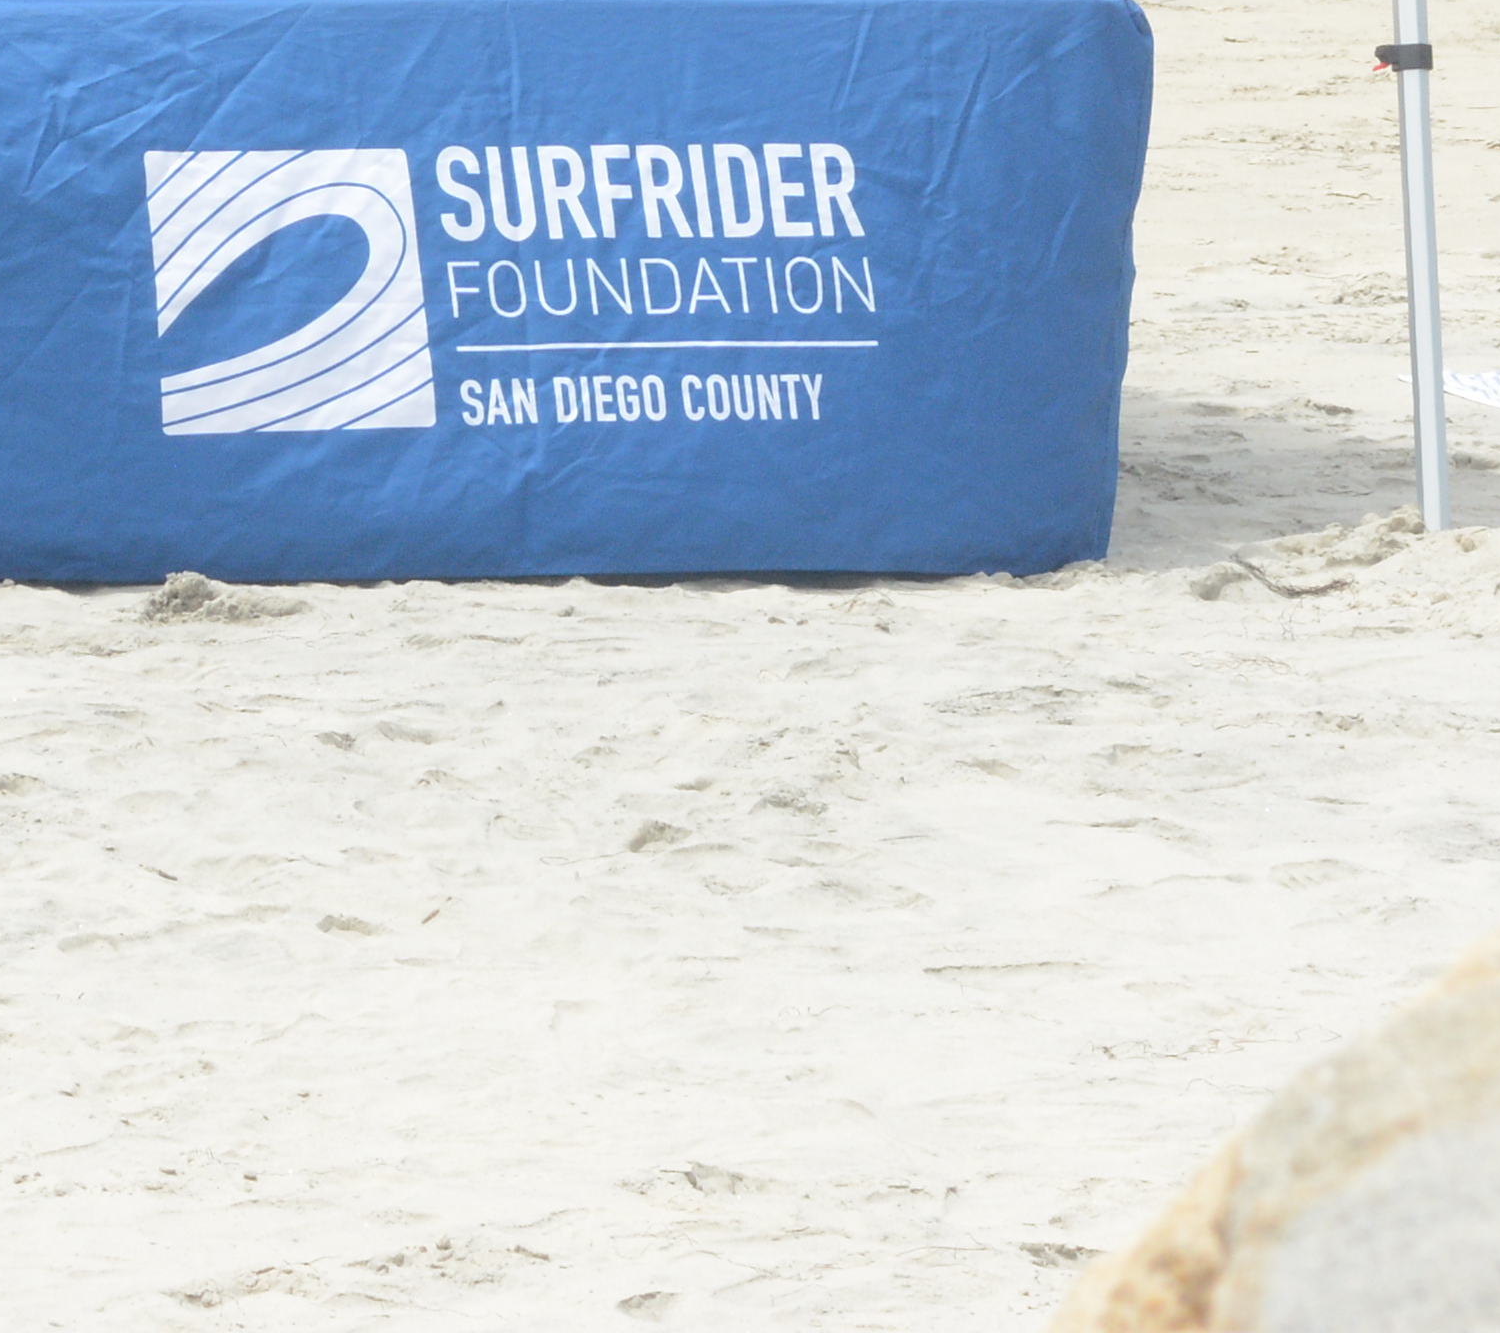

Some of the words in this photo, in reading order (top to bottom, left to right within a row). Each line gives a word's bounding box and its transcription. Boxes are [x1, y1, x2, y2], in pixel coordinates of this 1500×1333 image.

[436, 143, 865, 242] SURFRIDER
[447, 256, 876, 318] FOUNDATION
[460, 378, 538, 426] SAN
[553, 374, 667, 423] DIEGO
[681, 374, 823, 421] COUNTY
